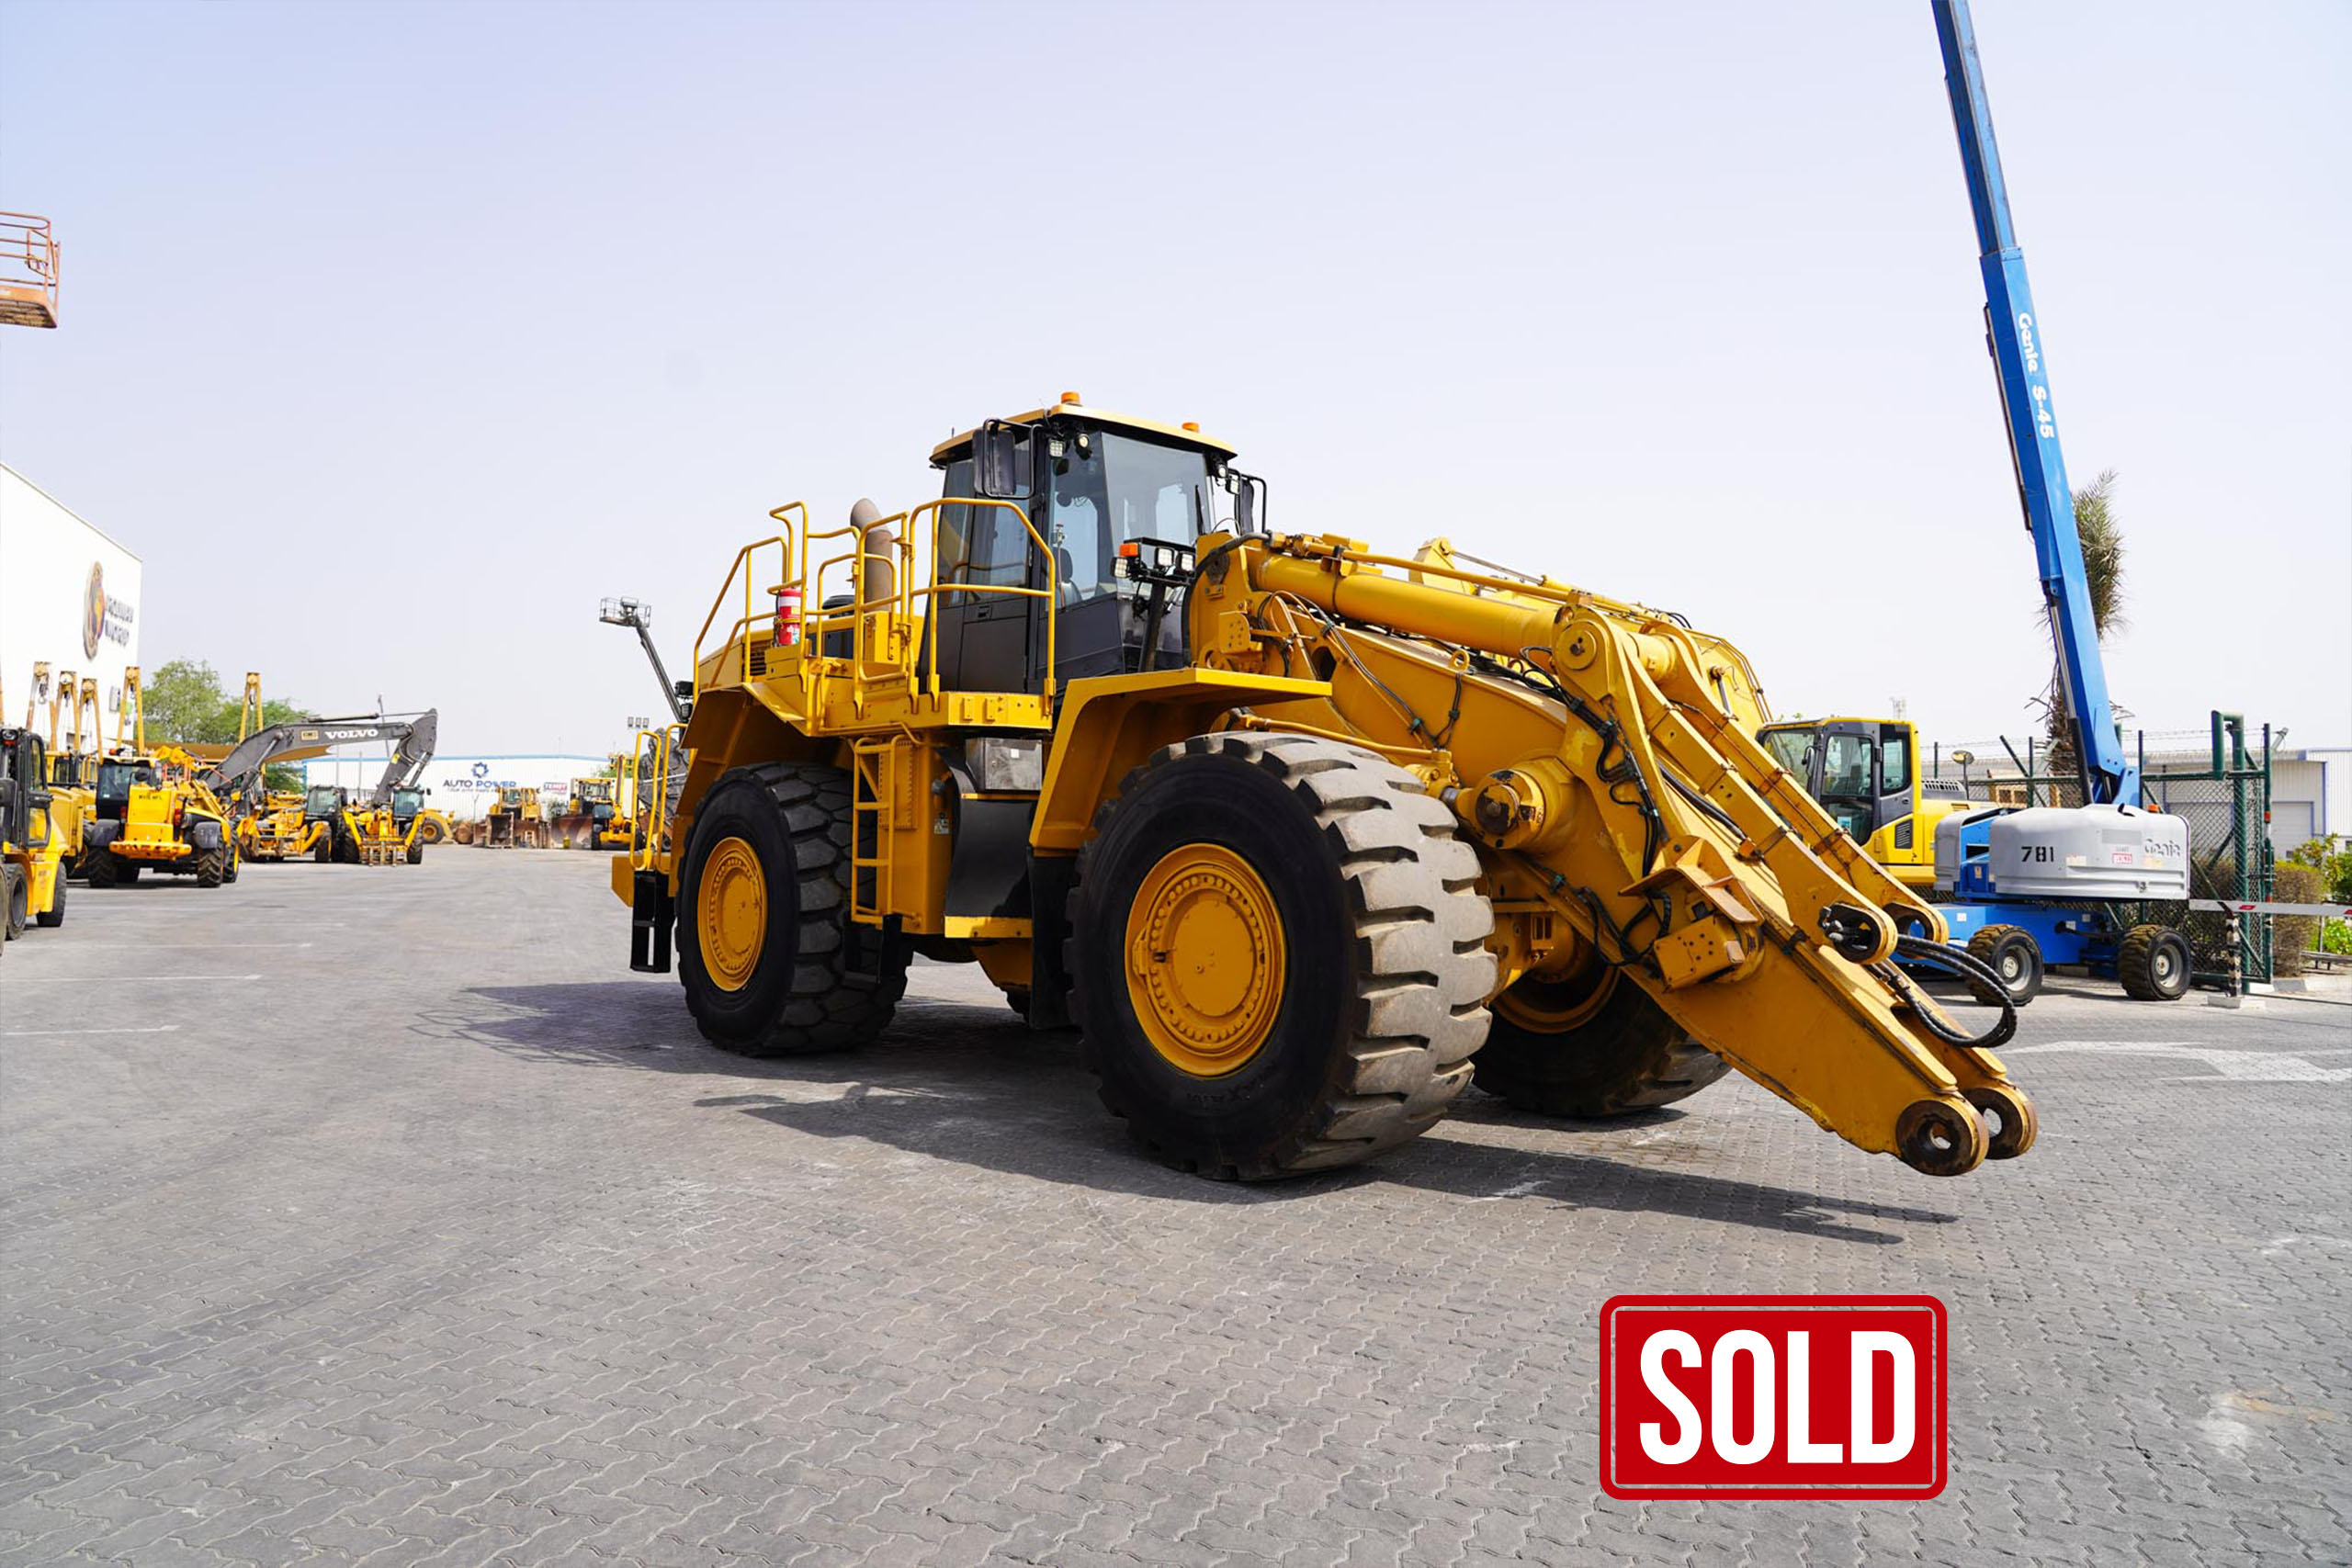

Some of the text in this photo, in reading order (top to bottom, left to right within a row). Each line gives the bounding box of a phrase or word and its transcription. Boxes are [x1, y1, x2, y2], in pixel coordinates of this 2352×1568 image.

[2018, 311, 2054, 439] Genie S-45
[324, 728, 379, 739] VOLVO
[2021, 846, 2054, 863] 781
